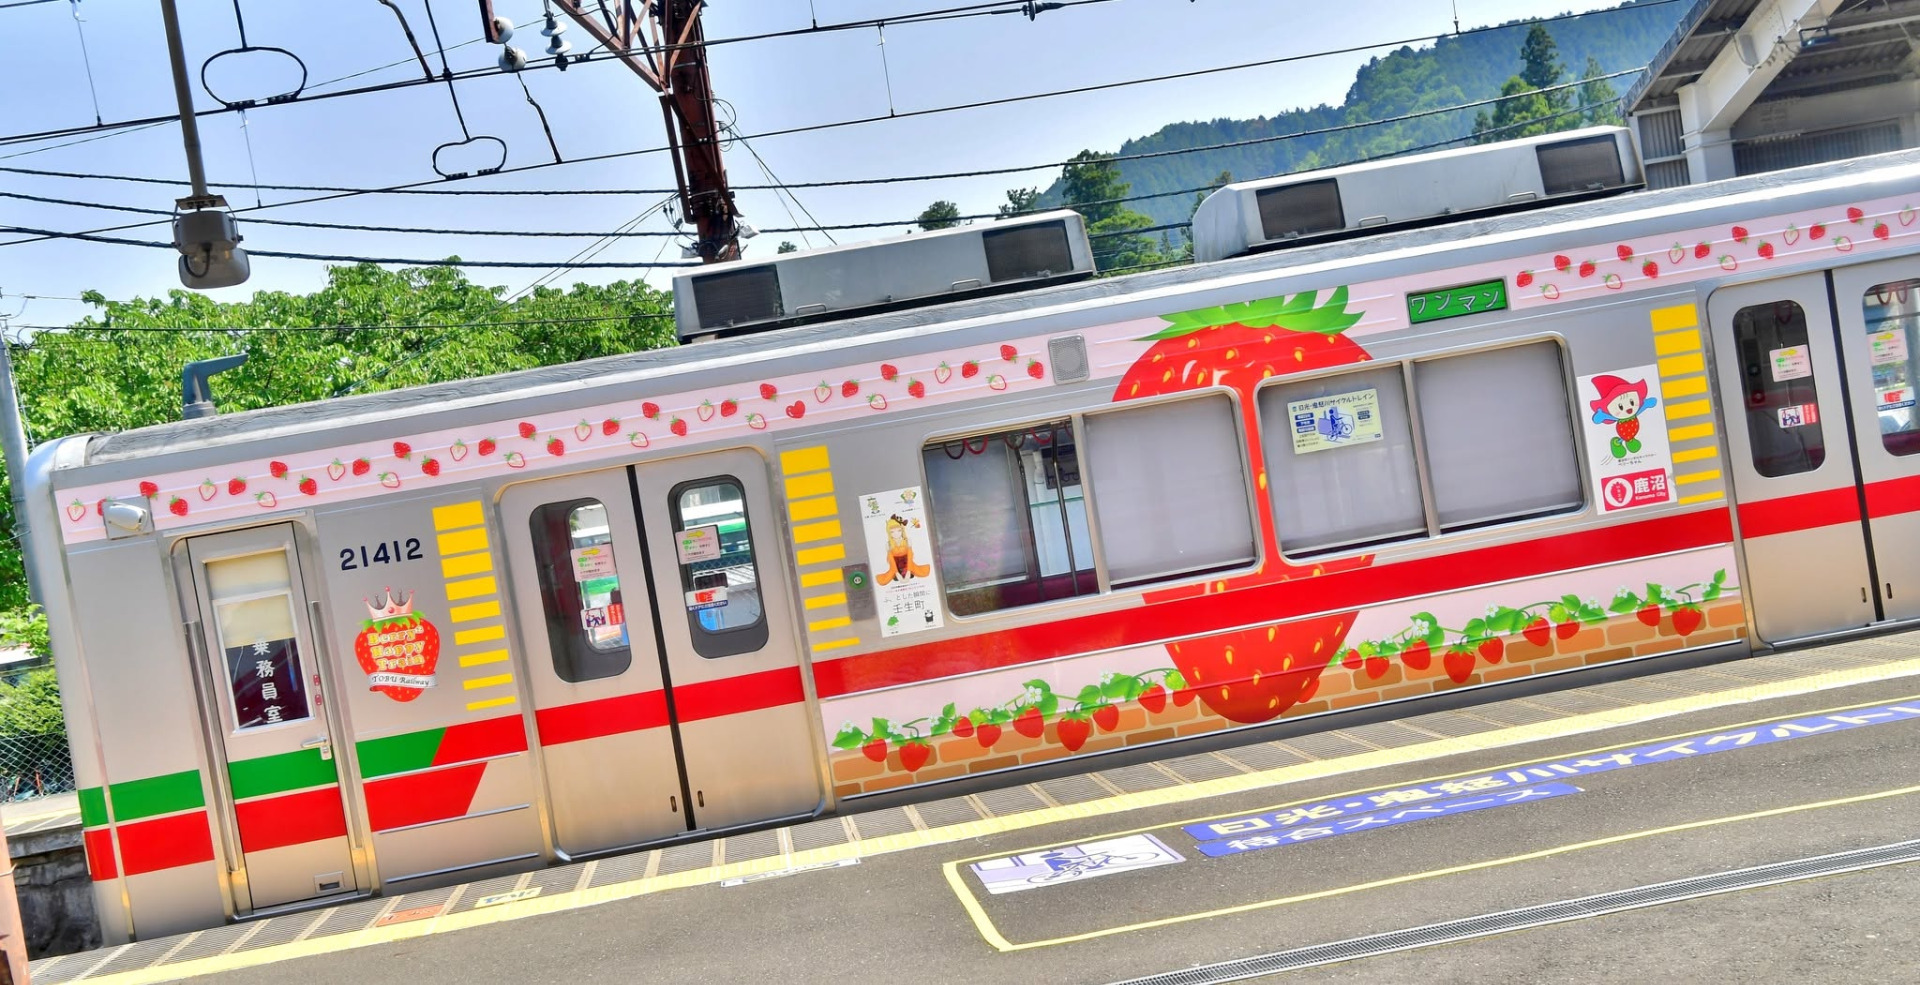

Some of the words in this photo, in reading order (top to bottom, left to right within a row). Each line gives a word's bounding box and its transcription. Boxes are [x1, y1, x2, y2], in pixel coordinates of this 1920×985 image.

[1410, 291, 1499, 314] ワンマン
[1634, 474, 1666, 493] 鹿沼
[340, 538, 423, 571] 21412
[893, 600, 925, 614] 壬生町
[371, 641, 425, 659] Happy
[252, 640, 284, 724] 乗務員室
[371, 674, 398, 684] TOBU
[399, 676, 430, 686] Railway
[1227, 788, 1551, 851] 待合スペース
